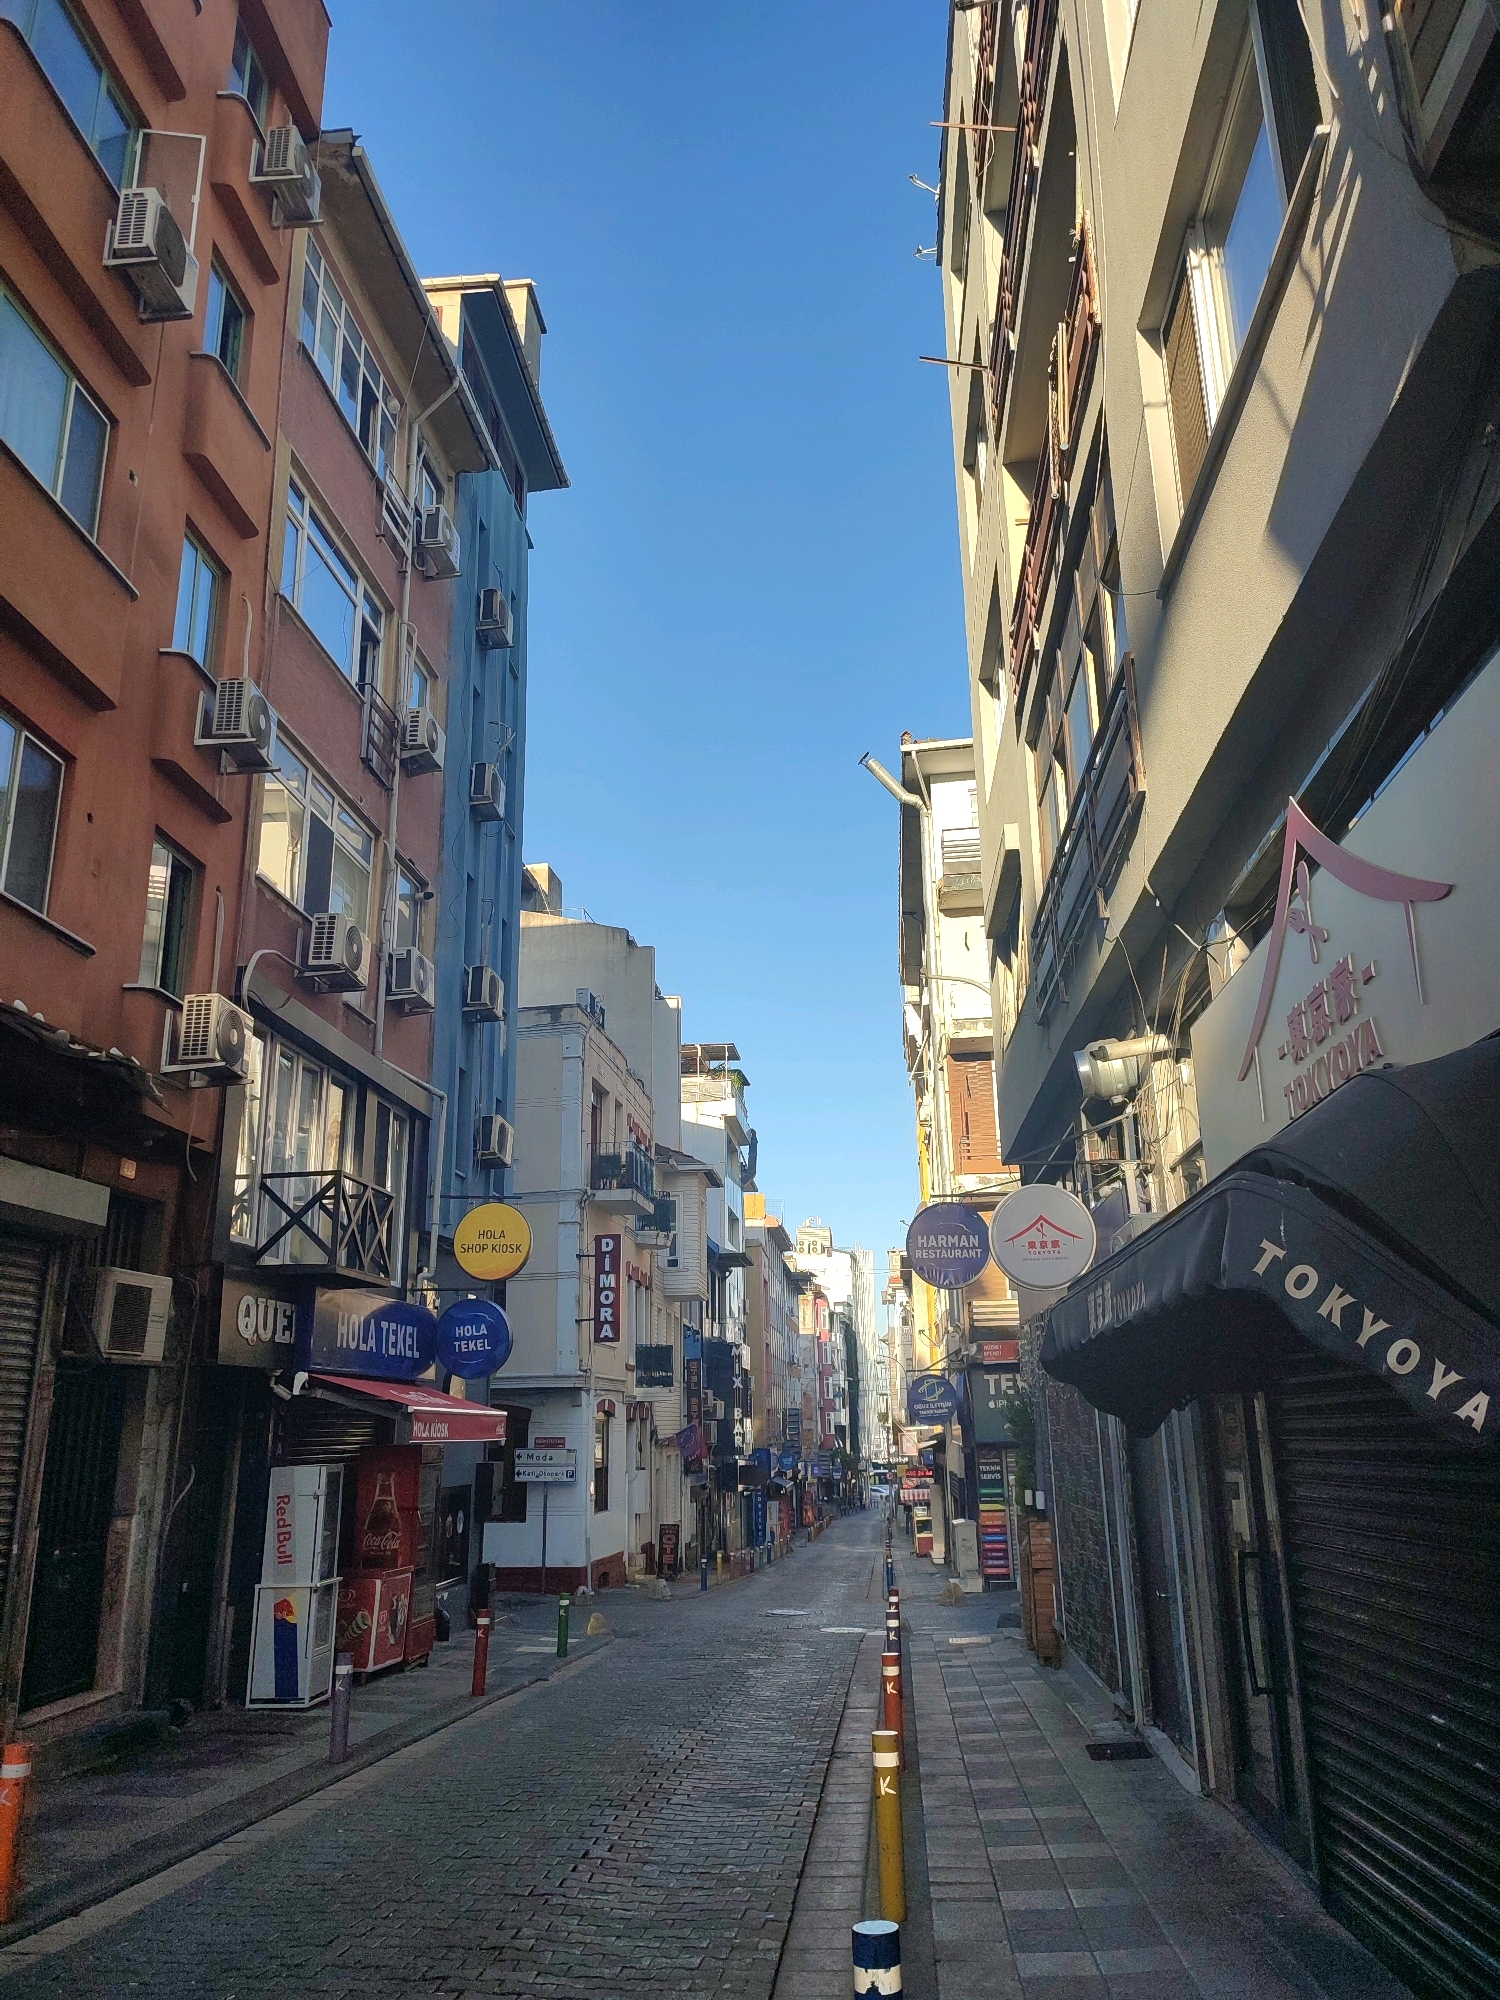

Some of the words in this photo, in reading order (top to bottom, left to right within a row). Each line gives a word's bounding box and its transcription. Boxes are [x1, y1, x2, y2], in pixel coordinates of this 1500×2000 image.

[1283, 1017, 1384, 1121] TOKYOYA
[477, 1229, 506, 1240] HOLA
[917, 1234, 979, 1248] HARMAN
[460, 1243, 489, 1254] SHOP
[915, 1248, 982, 1259] RESTAURANT
[237, 1294, 296, 1346] QUE
[336, 1311, 377, 1353] HOLA
[380, 1320, 420, 1359] TEKEL
[455, 1323, 488, 1338] HOLA
[1250, 1238, 1491, 1434] TOKYOYA
[453, 1338, 492, 1353] TEKEL
[412, 1420, 430, 1438] HOLA
[733, 1407, 745, 1448] BAR
[526, 1451, 554, 1462] Moda
[979, 1464, 1002, 1472] TEKNİK
[276, 1494, 291, 1529] Red
[276, 1529, 293, 1565] Bull
[362, 1531, 403, 1551] Coca-Cola
[560, 1608, 567, 1616] K
[477, 1629, 485, 1639] K
[889, 1630, 899, 1641] K
[335, 1679, 345, 1692] K
[886, 1681, 898, 1695] K
[879, 1774, 897, 1797] K
